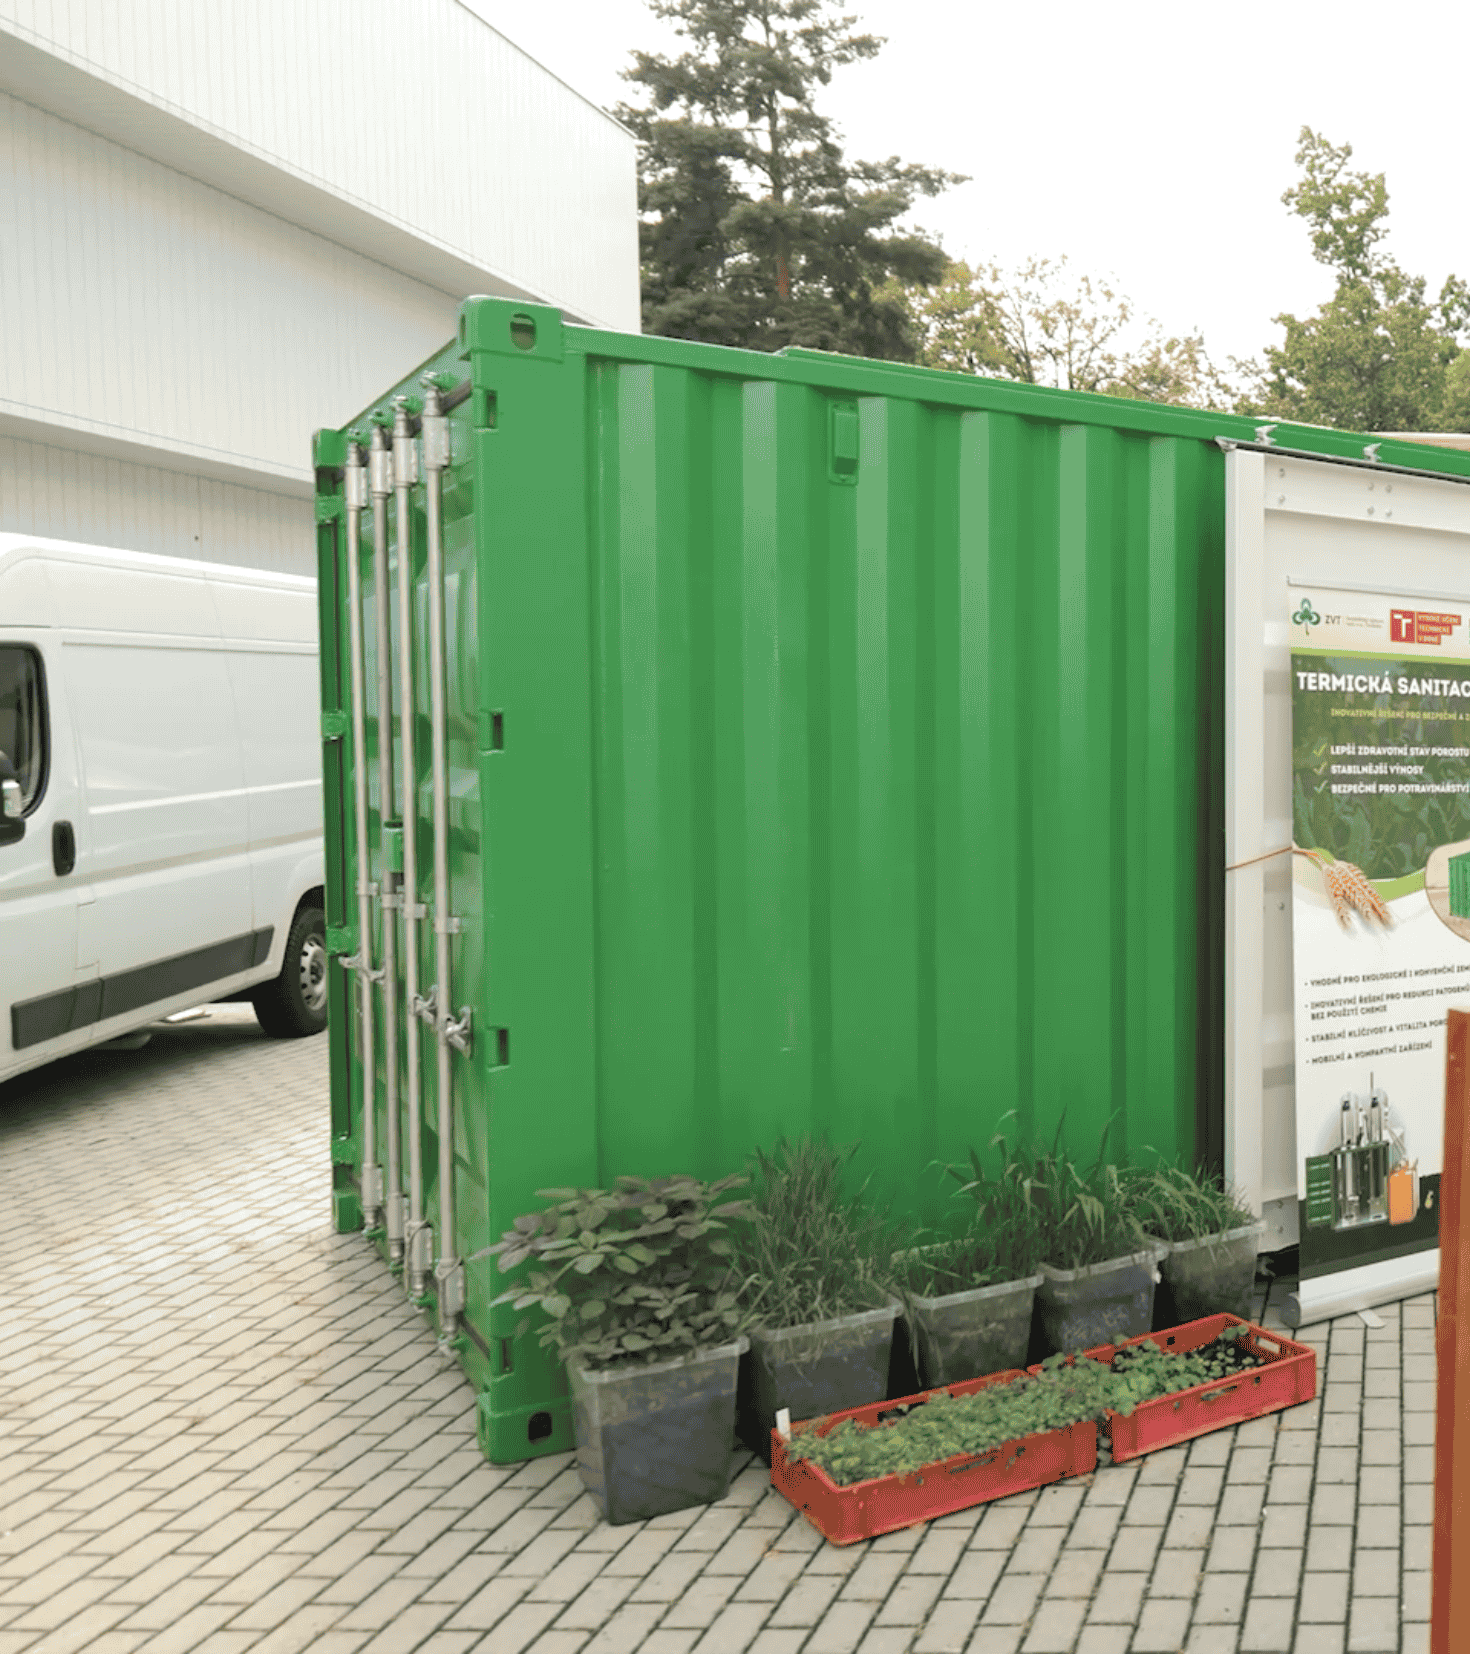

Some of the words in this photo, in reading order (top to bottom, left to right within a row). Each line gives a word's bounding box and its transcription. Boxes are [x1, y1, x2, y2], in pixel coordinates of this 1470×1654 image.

[1325, 615, 1341, 625] ZVT
[1296, 670, 1394, 695] TERMICKÁ
[1330, 743, 1356, 756] LEPŠÍ
[1358, 744, 1408, 756] ZDRAVOTNÍ
[1409, 747, 1430, 756] STAV
[1431, 746, 1470, 757] POROSTU
[1330, 761, 1388, 775] STABILNĚJŠÍ
[1389, 762, 1425, 775] VÝNOSY
[1331, 780, 1377, 794] BEZPEČNÉ
[1378, 783, 1396, 794] PRO
[1398, 781, 1470, 794] POTRAVINÁŘSTVÍ
[1343, 975, 1360, 984] PRO
[1385, 992, 1401, 1000] PRO
[1311, 1011, 1325, 1020] BEZ
